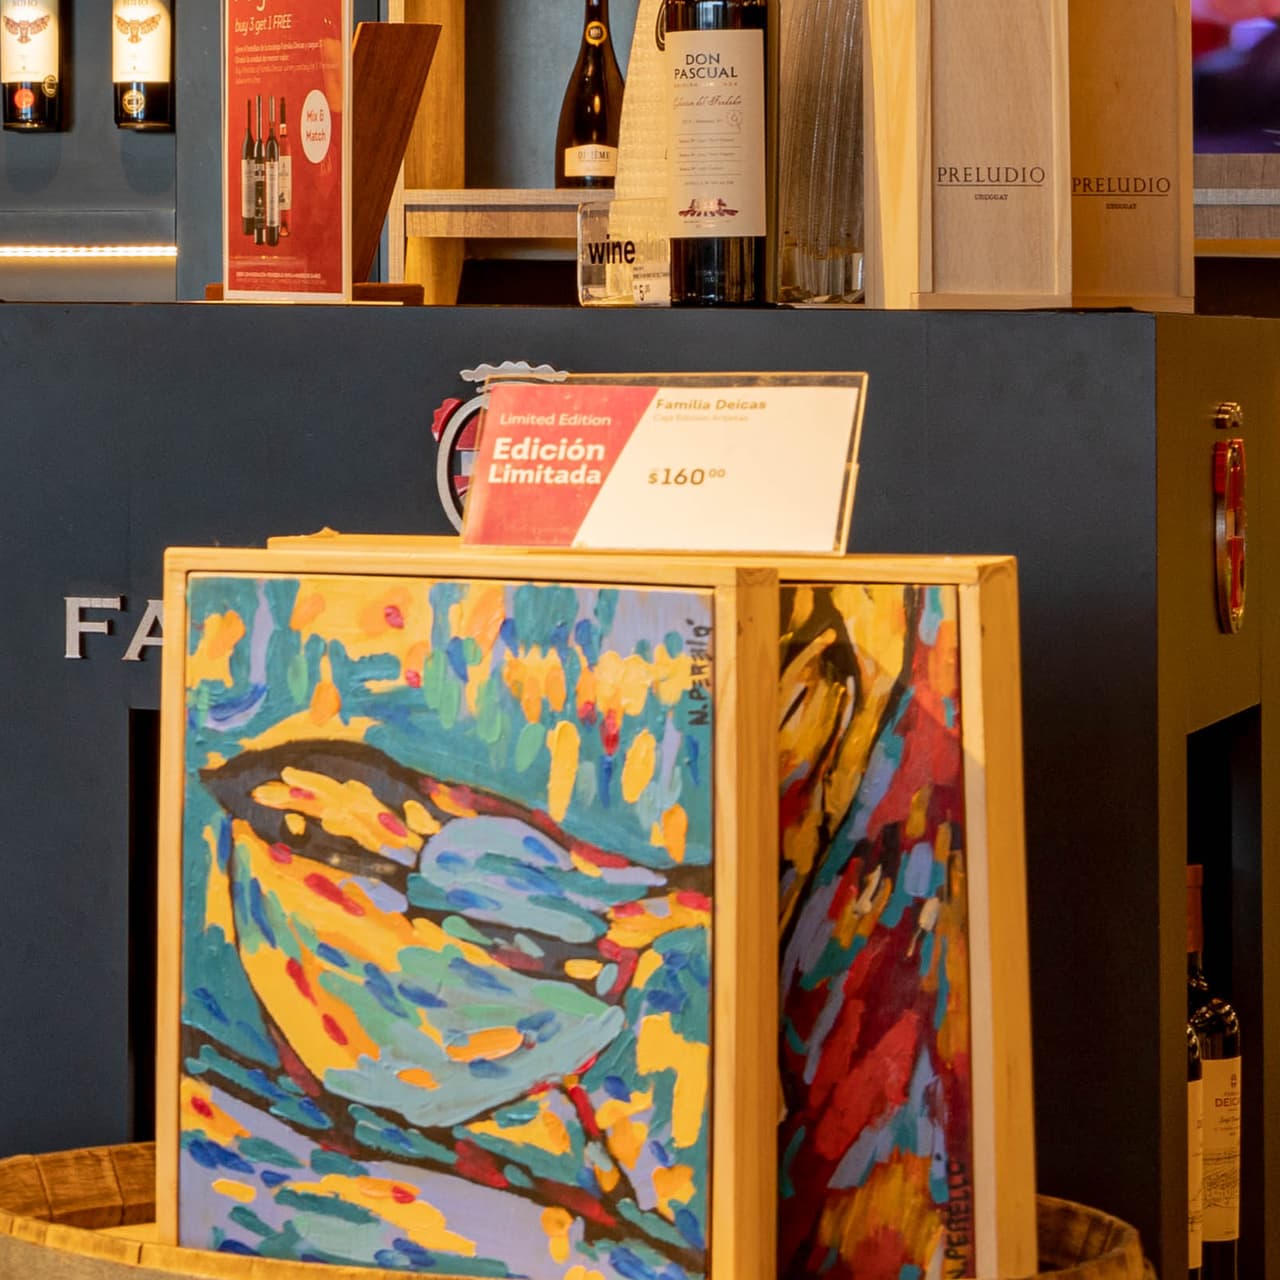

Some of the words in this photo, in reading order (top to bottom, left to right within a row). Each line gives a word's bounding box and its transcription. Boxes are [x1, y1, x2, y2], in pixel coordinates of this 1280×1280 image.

[685, 53, 720, 66] DON
[674, 66, 738, 80] PASCUAL
[937, 166, 1046, 184] PRELUDIO
[1071, 176, 1171, 193] PRELUDIO
[588, 234, 636, 265] wine
[655, 399, 711, 410] Familia
[715, 399, 767, 410] Deicas
[500, 413, 556, 426] Limited
[558, 413, 612, 426] Edition
[492, 437, 606, 462] Edición
[488, 463, 602, 485] Limitada
